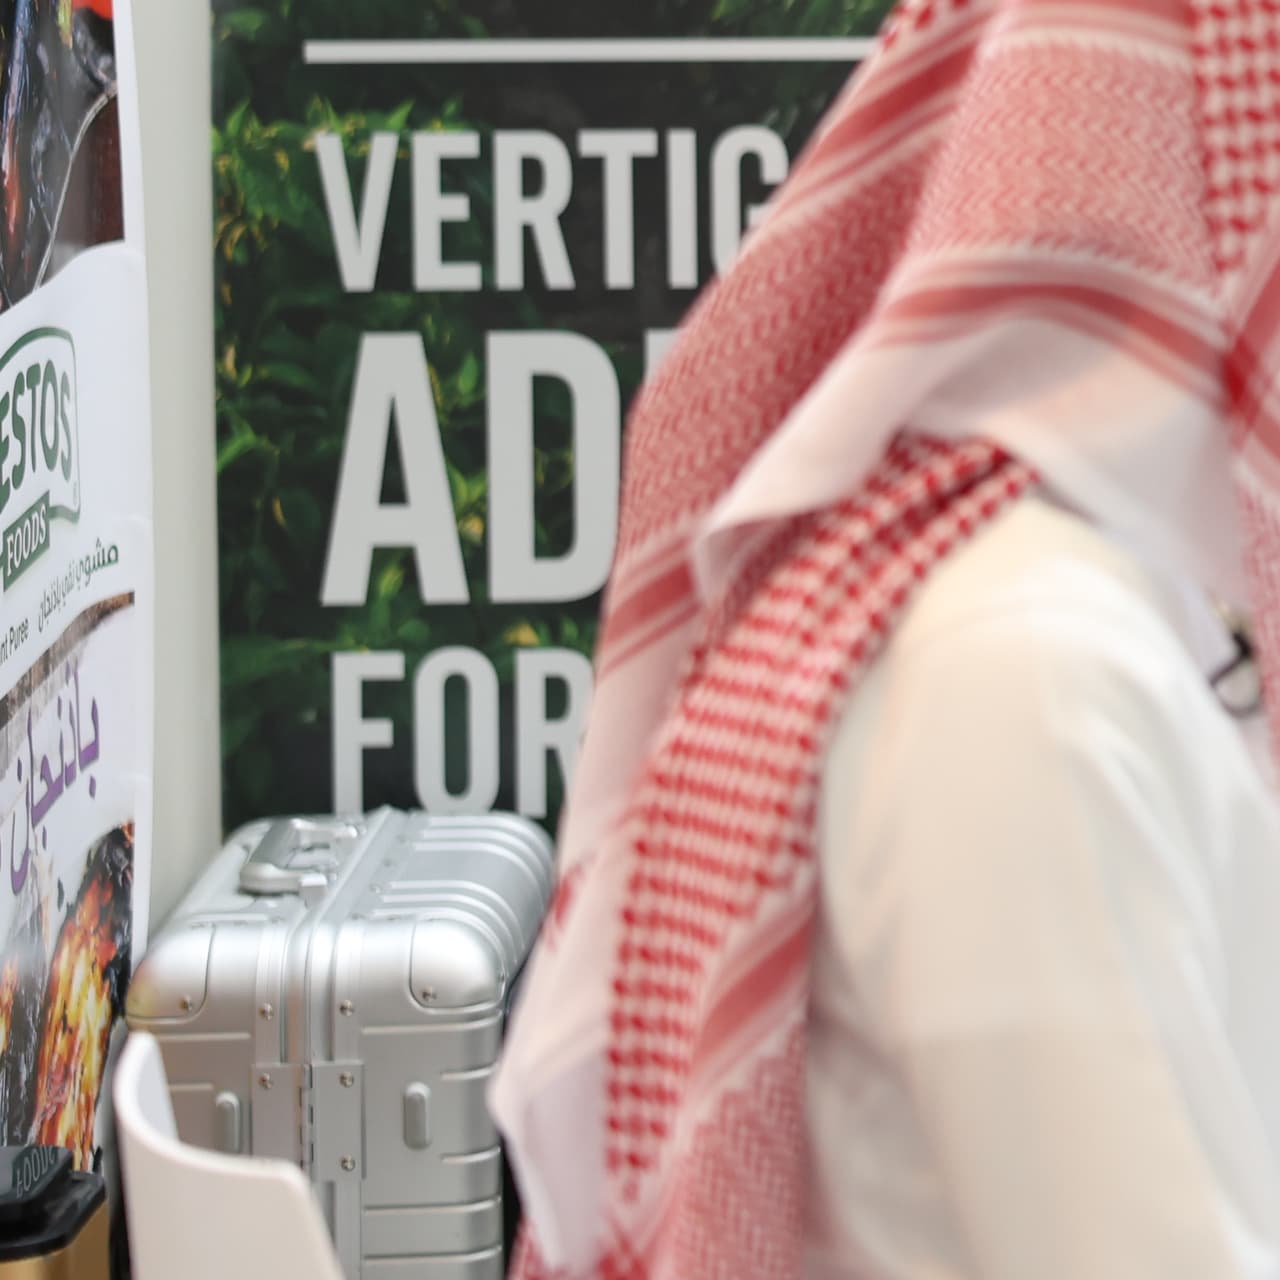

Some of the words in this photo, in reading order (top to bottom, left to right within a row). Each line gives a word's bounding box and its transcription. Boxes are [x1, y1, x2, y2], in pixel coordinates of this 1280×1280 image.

[320, 328, 682, 606] AD
[6, 503, 47, 577] FOODS
[9, 618, 29, 656] Puree
[331, 645, 595, 819] FOR
